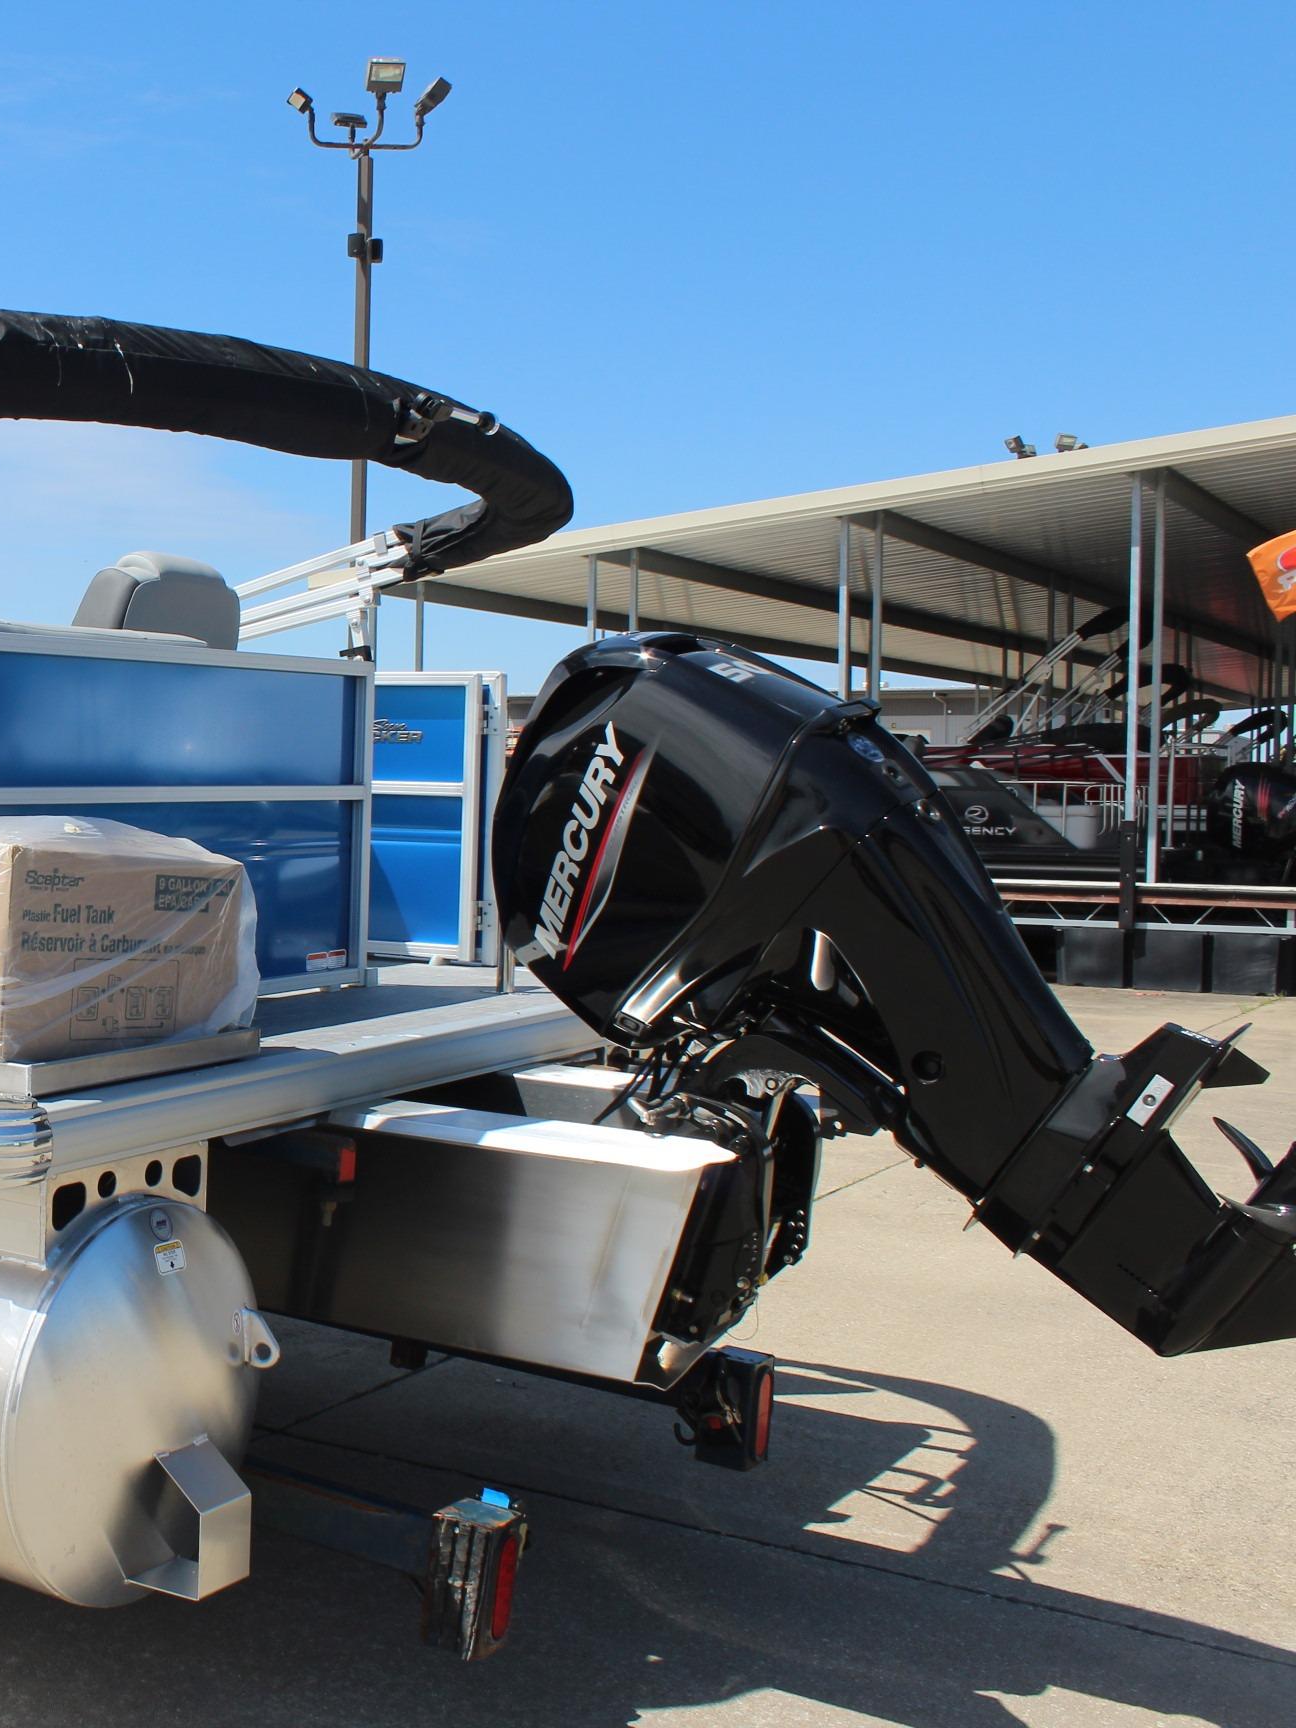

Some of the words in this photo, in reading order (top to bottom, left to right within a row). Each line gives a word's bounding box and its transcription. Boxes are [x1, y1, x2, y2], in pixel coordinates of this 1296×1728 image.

[1232, 779, 1245, 849] MERCURY
[534, 720, 624, 960] MERCURY
[22, 909, 52, 923] Plastic
[53, 903, 82, 924] Fuel
[85, 904, 115, 924] Tank
[21, 931, 86, 953] Réservoir
[89, 932, 97, 952] à
